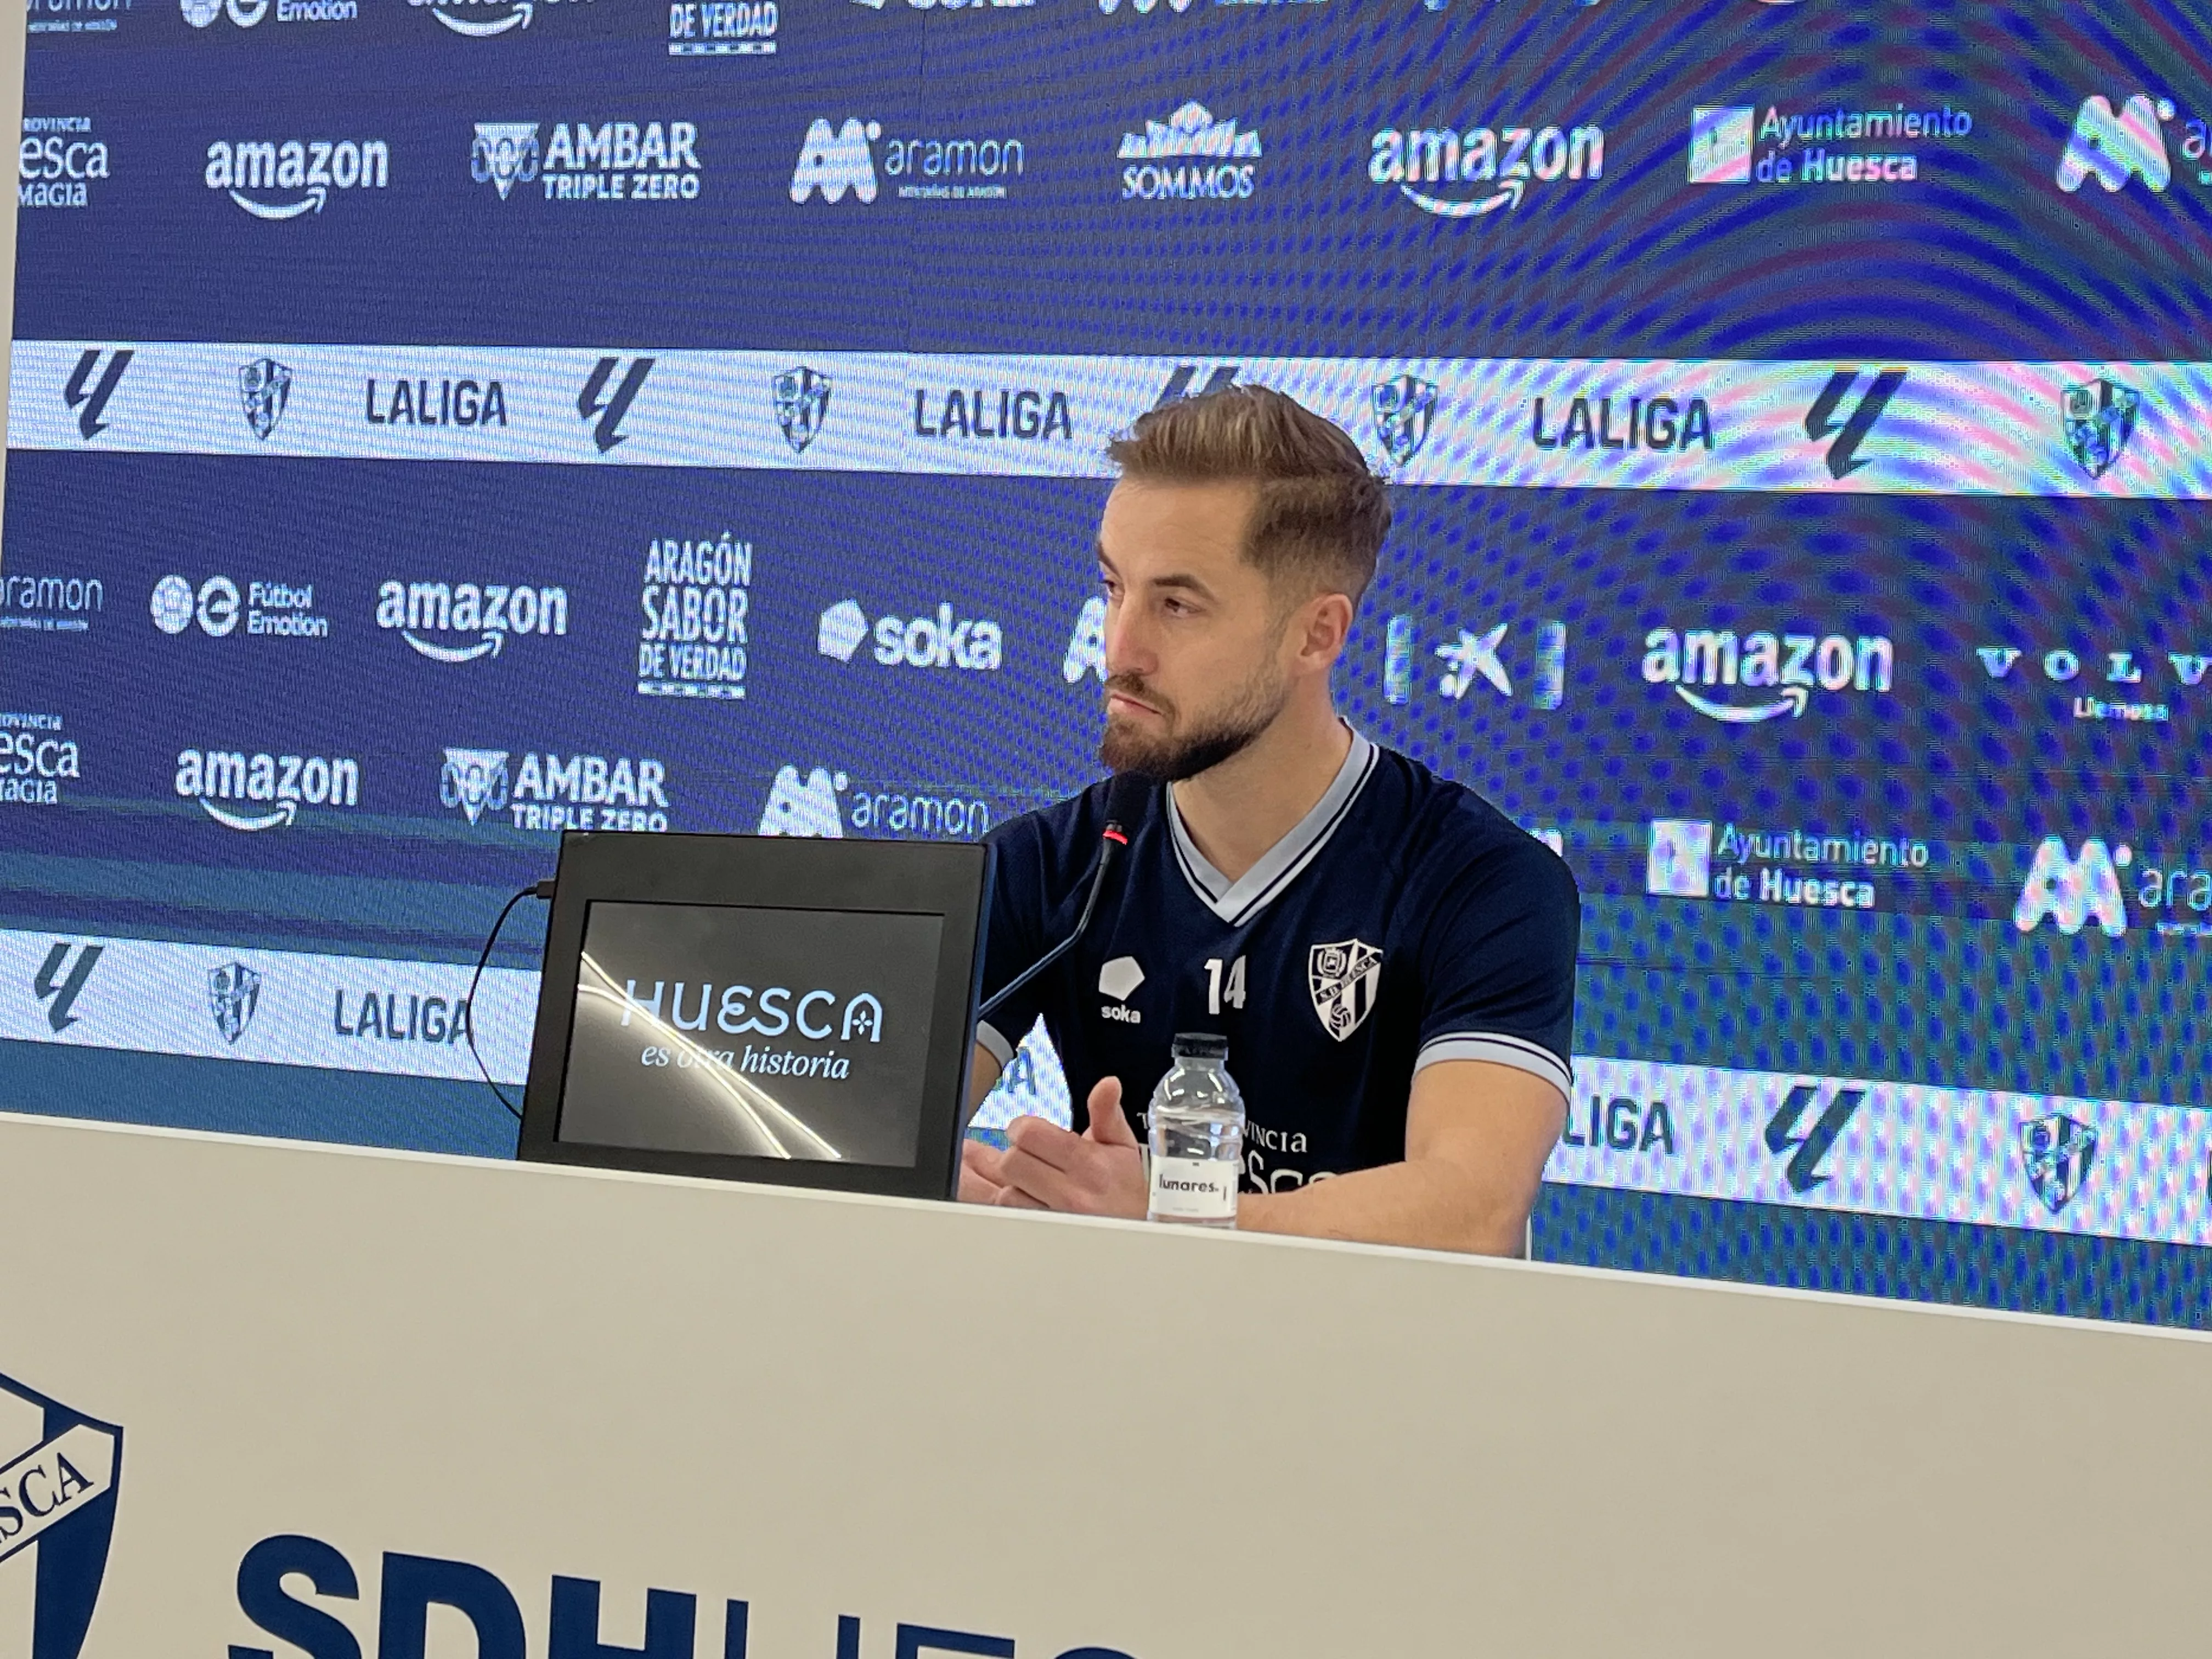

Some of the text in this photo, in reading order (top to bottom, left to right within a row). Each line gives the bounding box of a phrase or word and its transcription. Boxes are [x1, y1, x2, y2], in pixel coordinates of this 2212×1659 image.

[670, 2, 779, 38] DE VERDAD
[543, 122, 702, 170] AMBAR
[1759, 104, 1972, 148] Ayuntamiento
[19, 136, 110, 179] esca
[205, 139, 388, 189] amazon
[884, 139, 1024, 176] aramon
[1368, 126, 1605, 183] amazon
[1757, 149, 1918, 182] de Huesca
[542, 174, 701, 200] TRIPLE ZERO
[1122, 164, 1255, 200] SOMMOS
[366, 380, 508, 426] LALIGA
[915, 390, 1073, 439] LALIGA
[1533, 397, 1713, 452] LALIGA
[643, 530, 753, 586] ARAGÓN
[0, 575, 103, 612] ramon
[249, 582, 313, 608] Fútbol
[376, 580, 568, 635] amazon
[641, 586, 748, 643] SABOR
[247, 610, 328, 637] Emotion
[874, 602, 1002, 670] soka
[638, 642, 747, 680] DE VERDAD
[1642, 627, 1894, 692] amazon
[1977, 646, 2212, 685] VOLV
[0, 731, 81, 778] esca
[176, 749, 359, 805] amazon
[512, 753, 669, 807] AMBAR
[510, 803, 668, 832] TRIPLE ZERO
[851, 791, 989, 836] aramon
[1717, 822, 1929, 868] Ayuntamiento
[1714, 868, 1875, 908] de Huesca
[2138, 869, 2212, 912] ara
[1204, 955, 1246, 1014] 14
[334, 989, 474, 1045] LALIGA
[620, 980, 883, 1042] HUESCA
[1101, 1004, 1141, 1024] soka
[641, 1045, 850, 1080] es ora historia
[1564, 1094, 1673, 1154] LIGA
[0, 1452, 94, 1537] SCA
